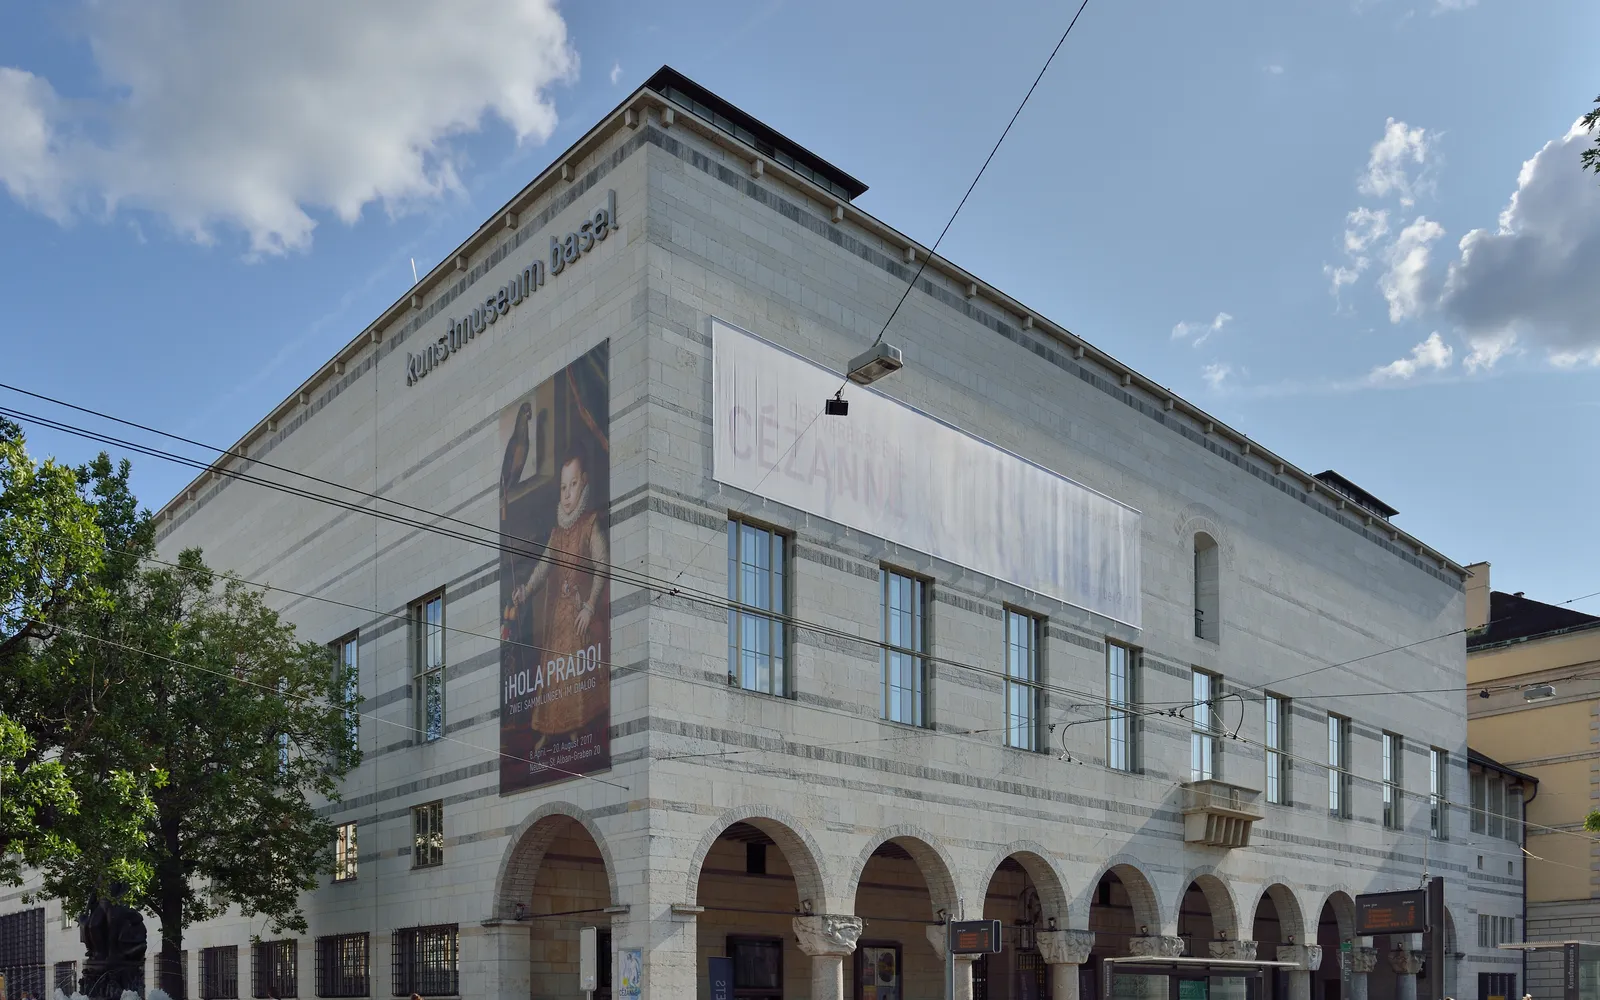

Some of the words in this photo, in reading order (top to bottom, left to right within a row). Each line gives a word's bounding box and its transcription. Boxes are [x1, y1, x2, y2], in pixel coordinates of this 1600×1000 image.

[406, 259, 544, 387] kunstmuseum
[549, 188, 619, 276] basel
[547, 643, 602, 685] PRADO!
